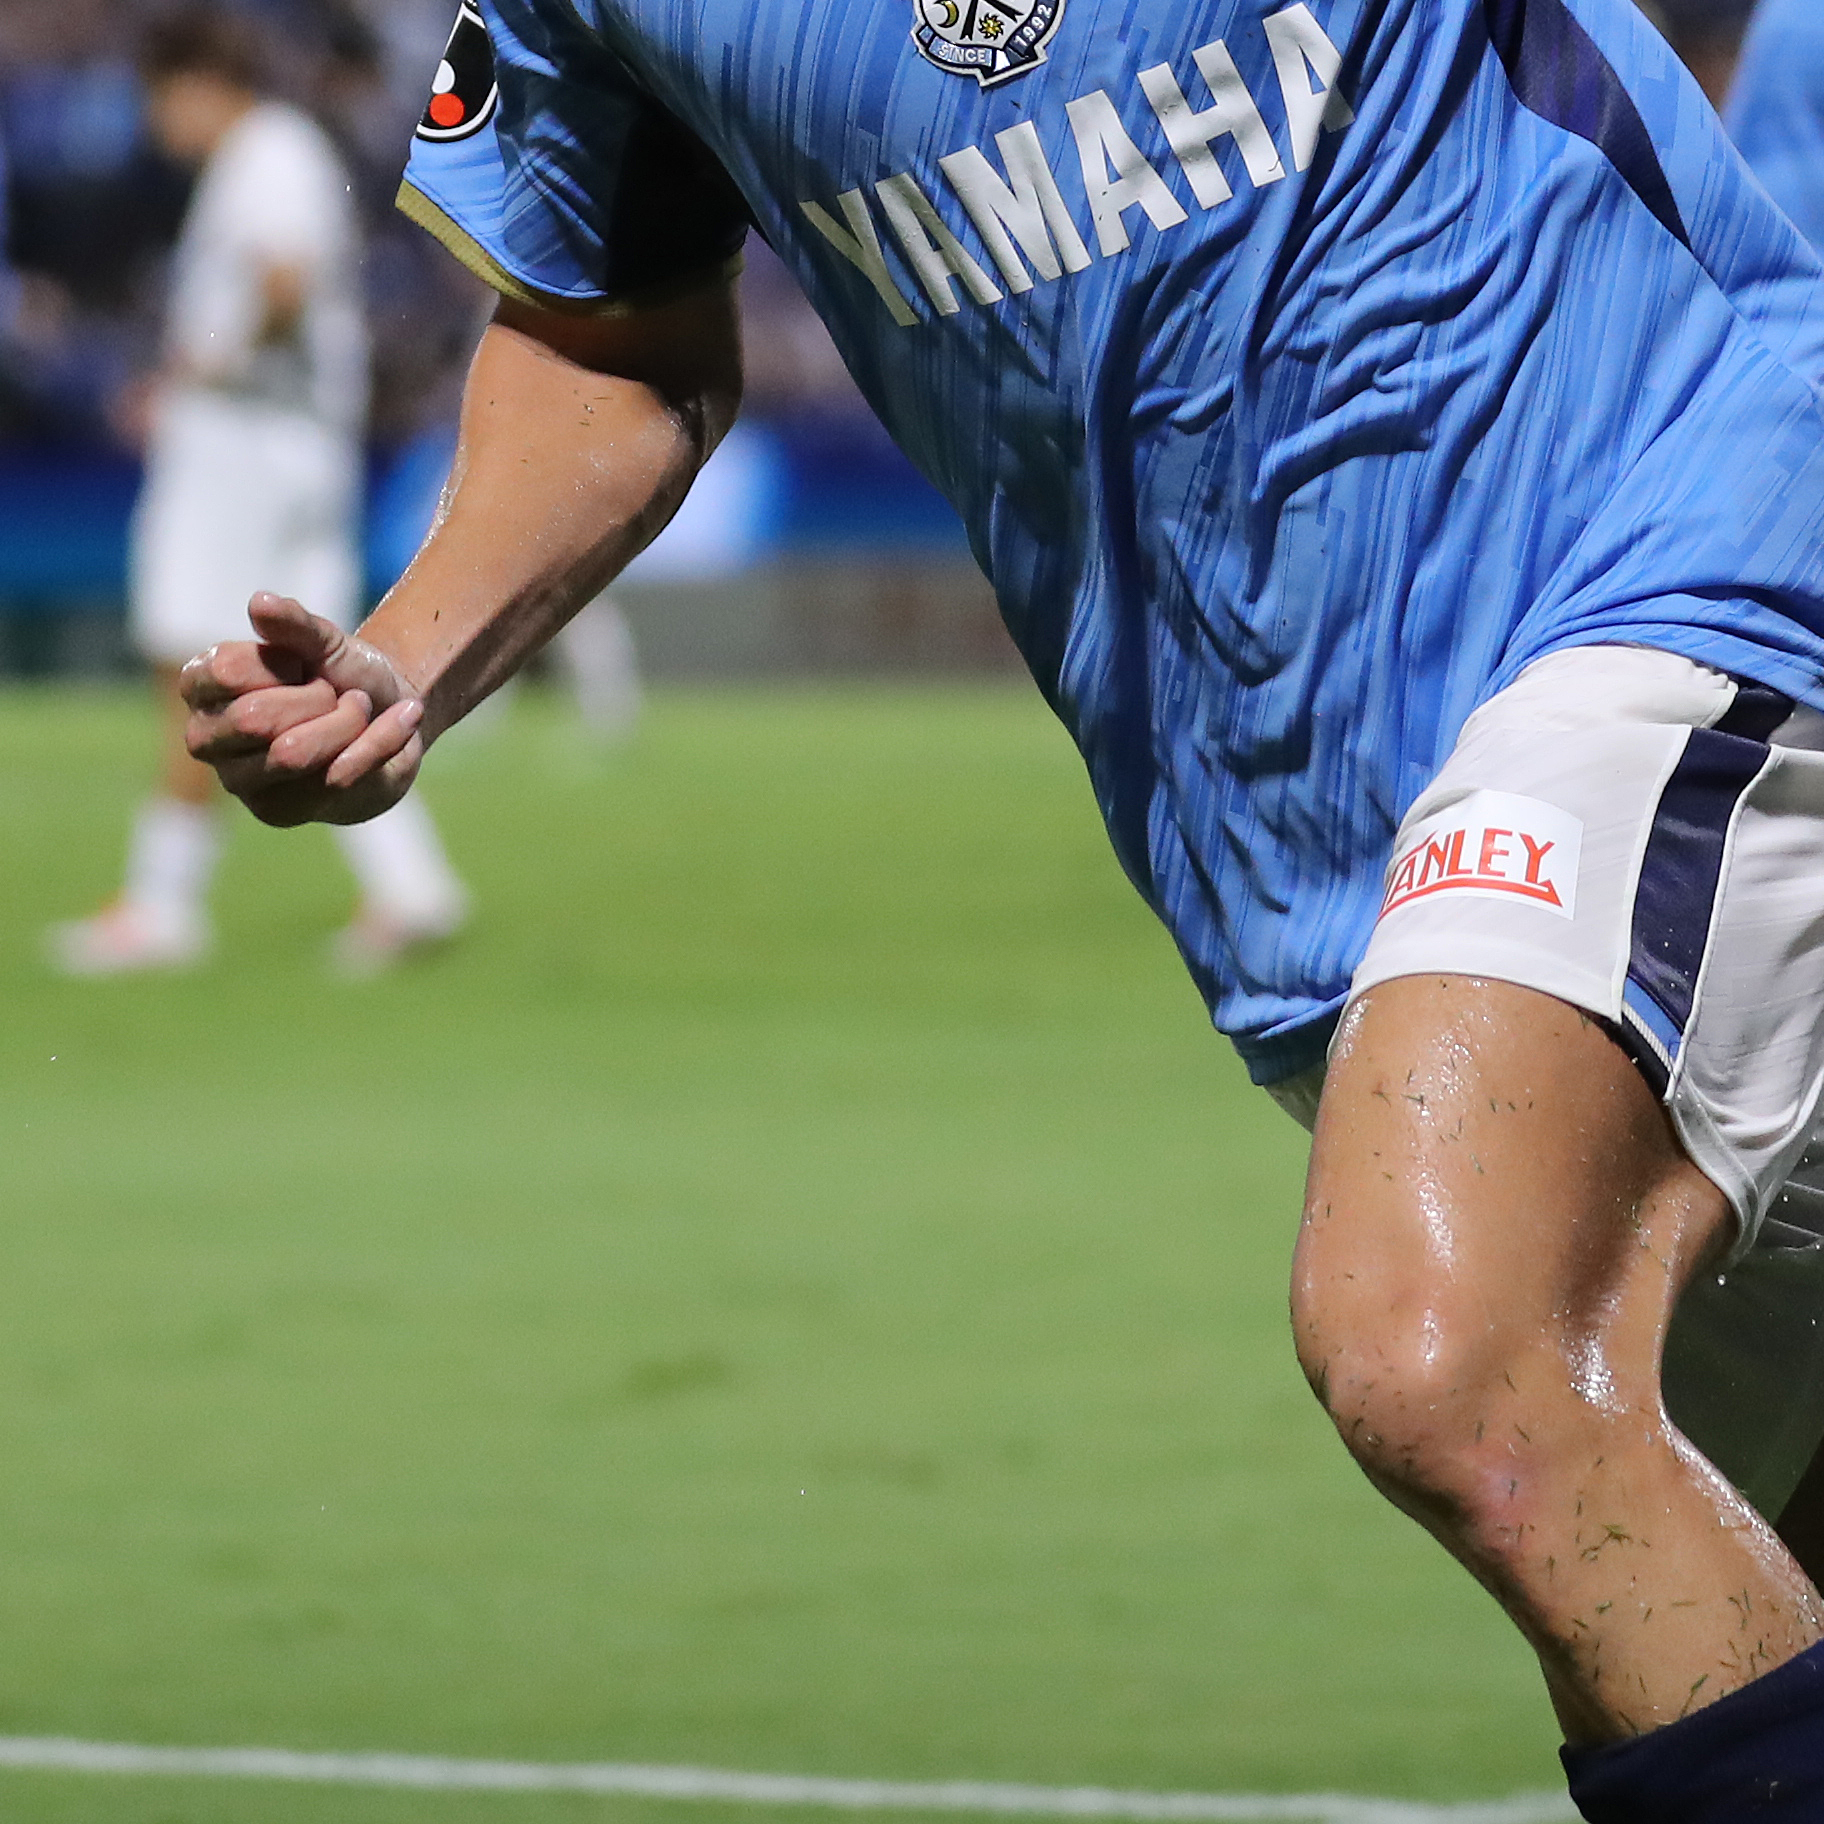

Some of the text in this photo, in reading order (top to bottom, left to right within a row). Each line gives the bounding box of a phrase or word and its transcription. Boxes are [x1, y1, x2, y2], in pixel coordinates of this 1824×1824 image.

[938, 4, 1053, 63] SINCE 1992
[798, 2, 1356, 327] YAMAHA
